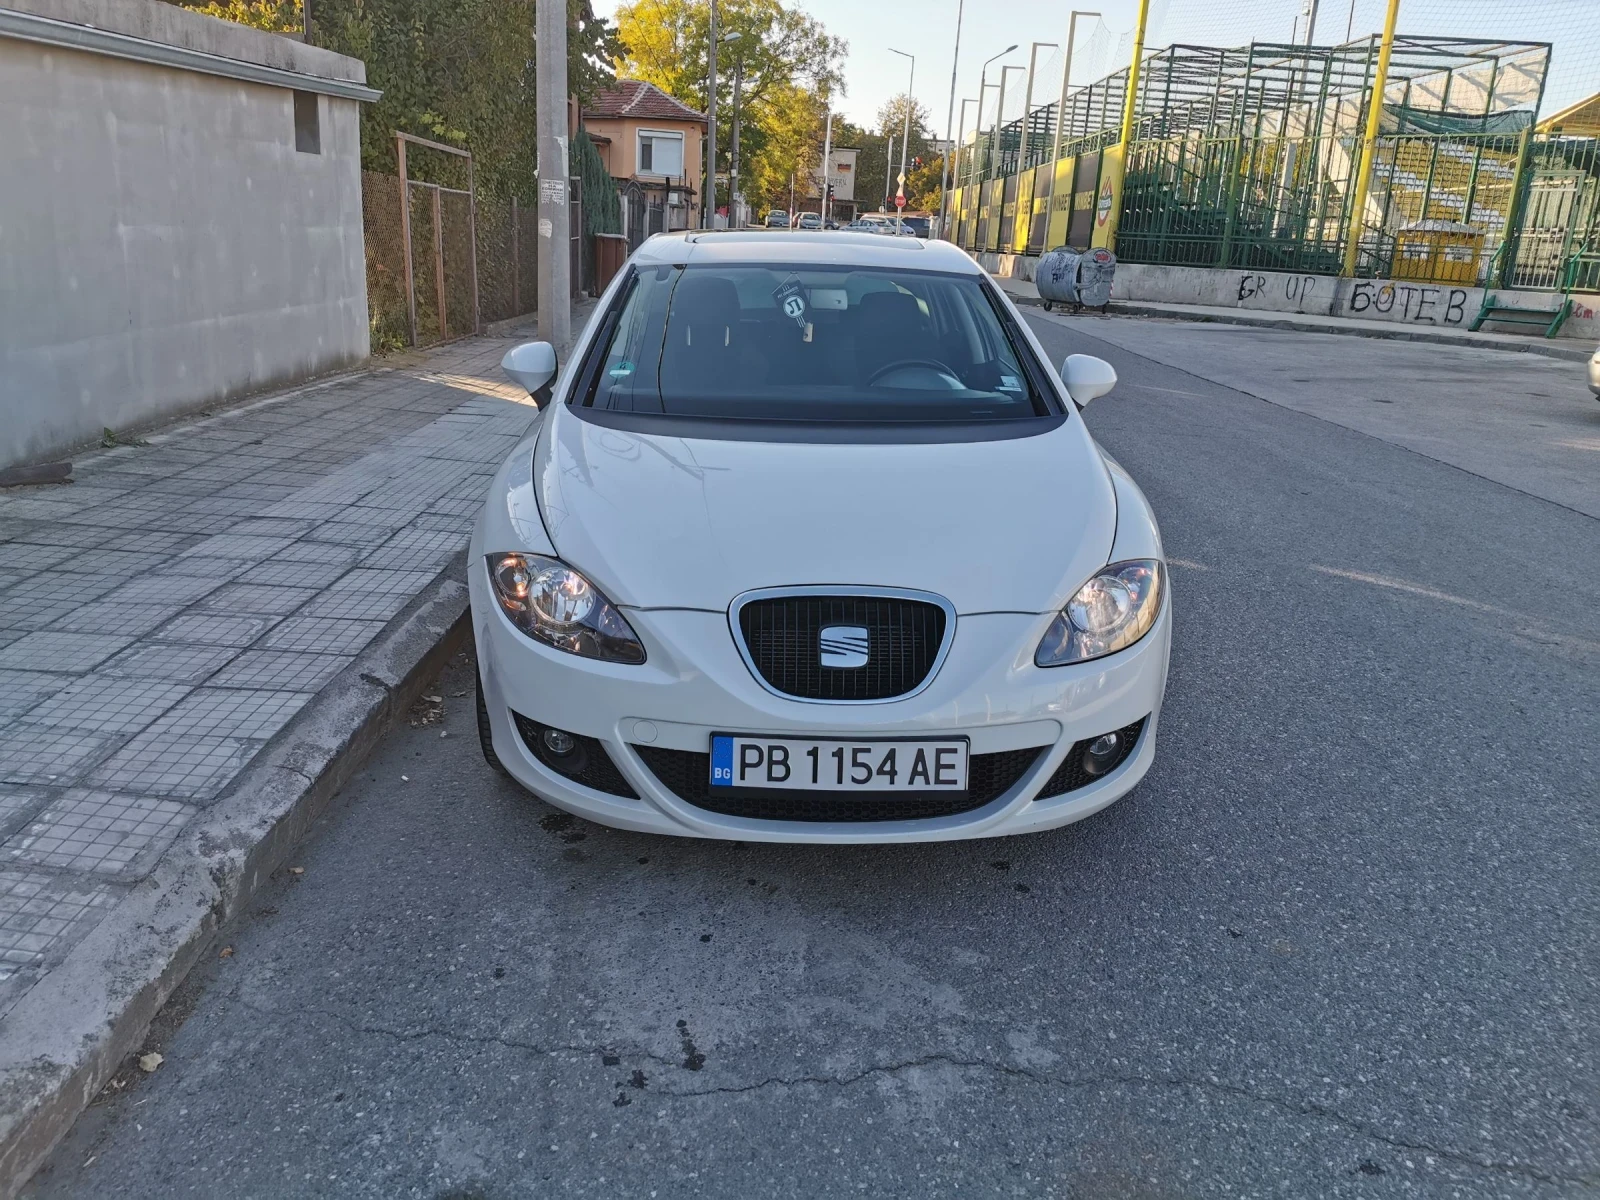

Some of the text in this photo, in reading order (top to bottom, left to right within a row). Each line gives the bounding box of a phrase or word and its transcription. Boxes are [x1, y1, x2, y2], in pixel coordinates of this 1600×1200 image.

[1286, 276, 1316, 308] UP
[714, 767, 731, 779] BG
[739, 744, 958, 785] PB 1154 AE
